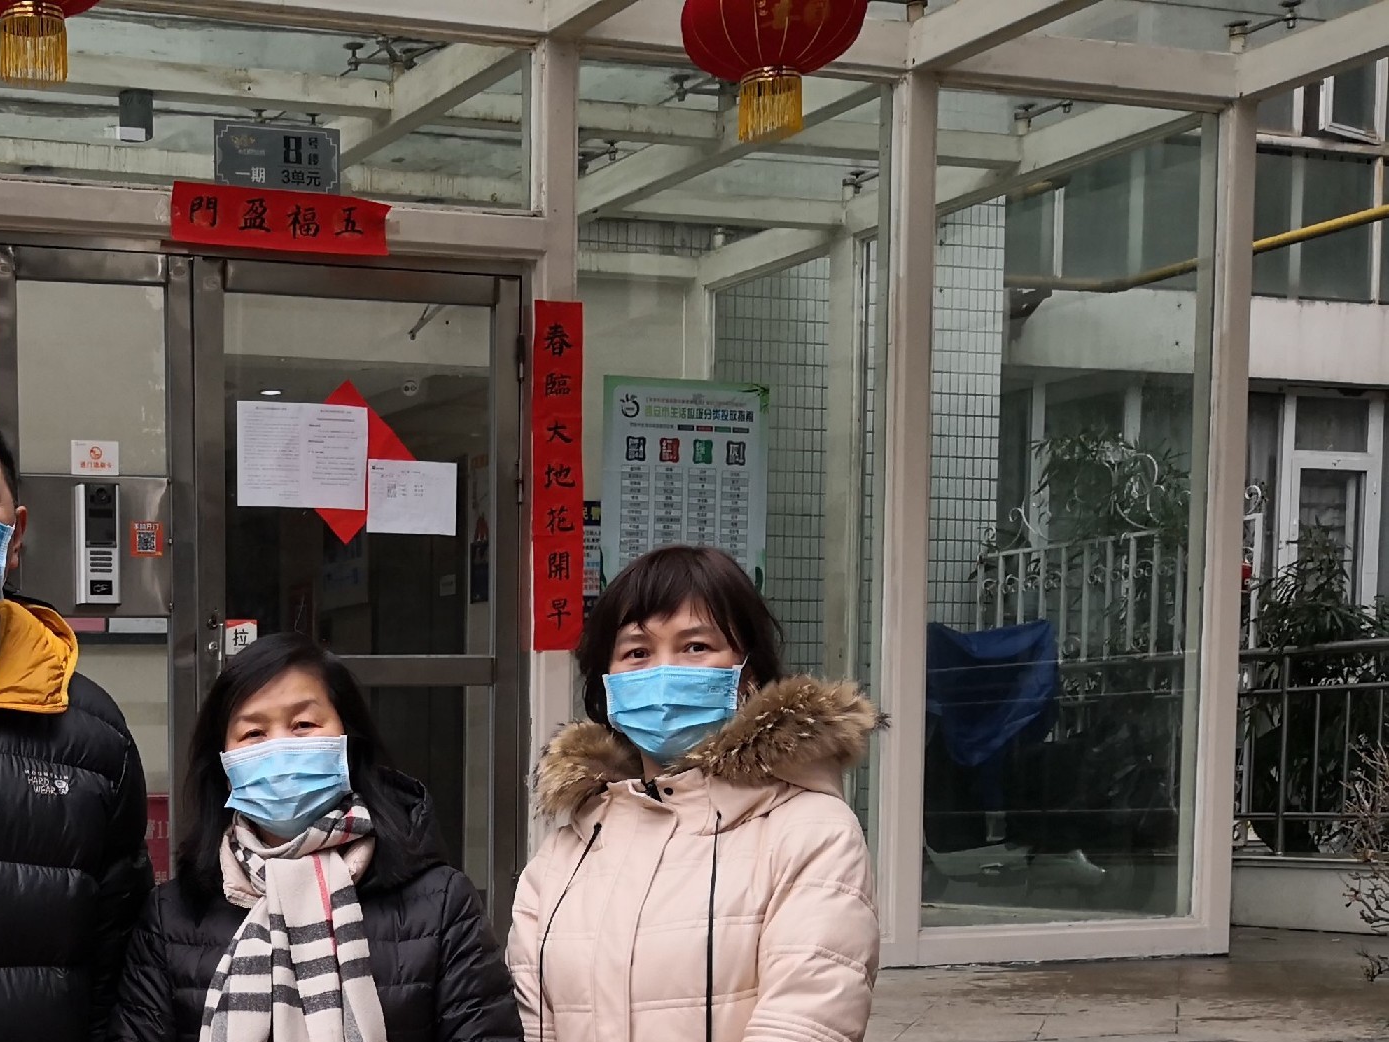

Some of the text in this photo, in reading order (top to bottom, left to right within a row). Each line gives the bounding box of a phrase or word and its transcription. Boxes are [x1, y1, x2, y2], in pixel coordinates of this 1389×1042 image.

[235, 166, 266, 184] 一期
[281, 169, 322, 187] 3单元
[543, 321, 577, 631] 春臨大地花開早
[232, 628, 250, 646] 拉
[27, 776, 50, 785] HARD
[33, 784, 57, 796] WEAR
